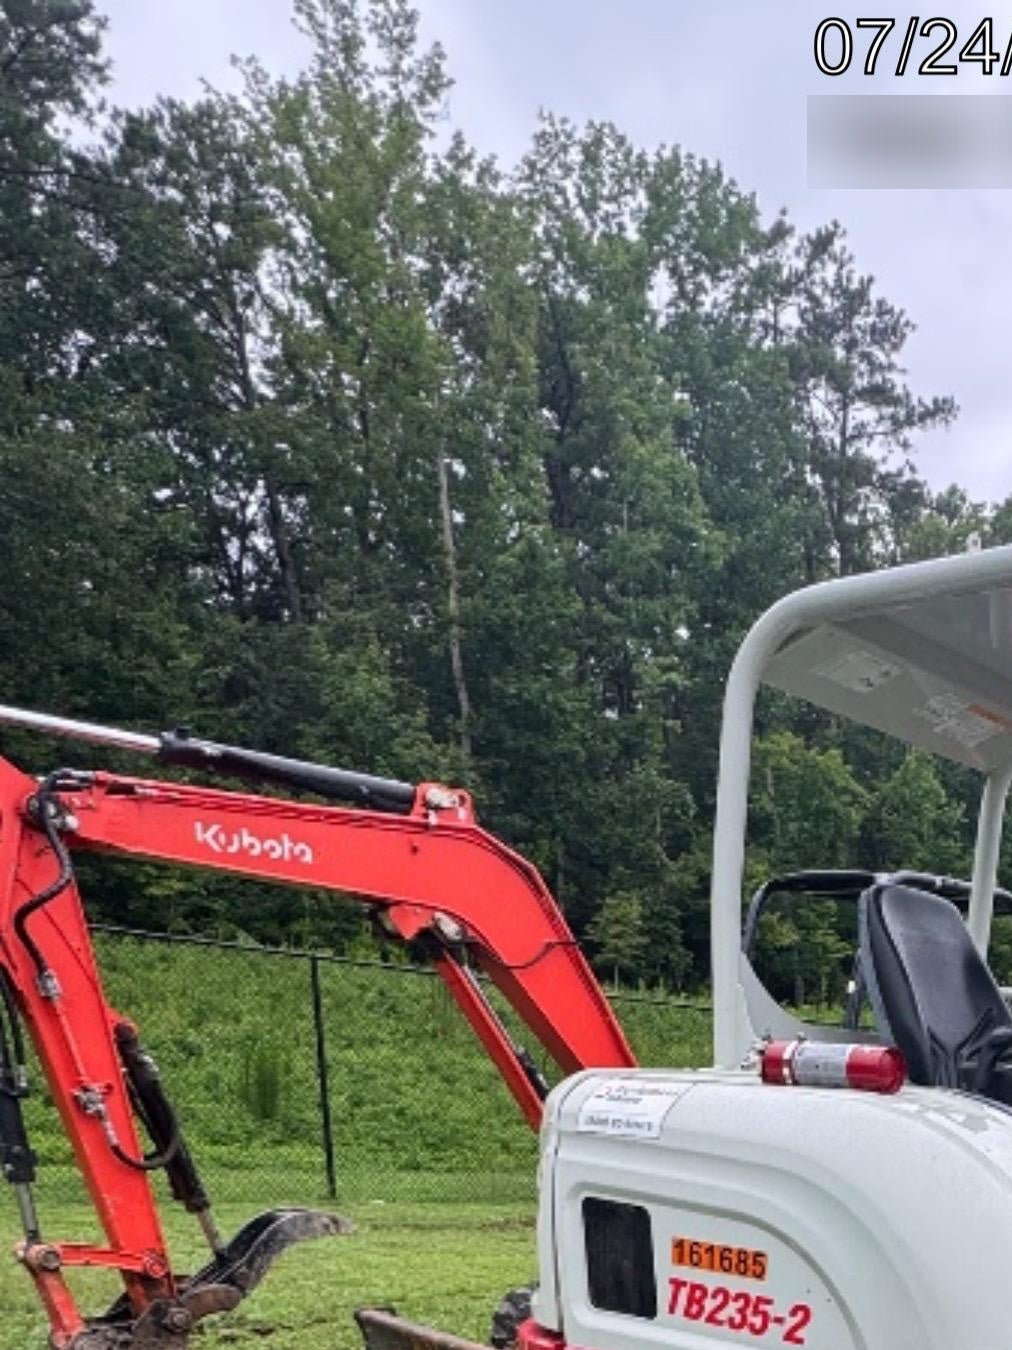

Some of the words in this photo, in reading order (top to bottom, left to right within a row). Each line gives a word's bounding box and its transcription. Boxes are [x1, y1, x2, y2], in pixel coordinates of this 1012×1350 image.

[194, 821, 313, 864] Kubota
[673, 1238, 766, 1280] 161685
[667, 1277, 812, 1345] TB235-2
